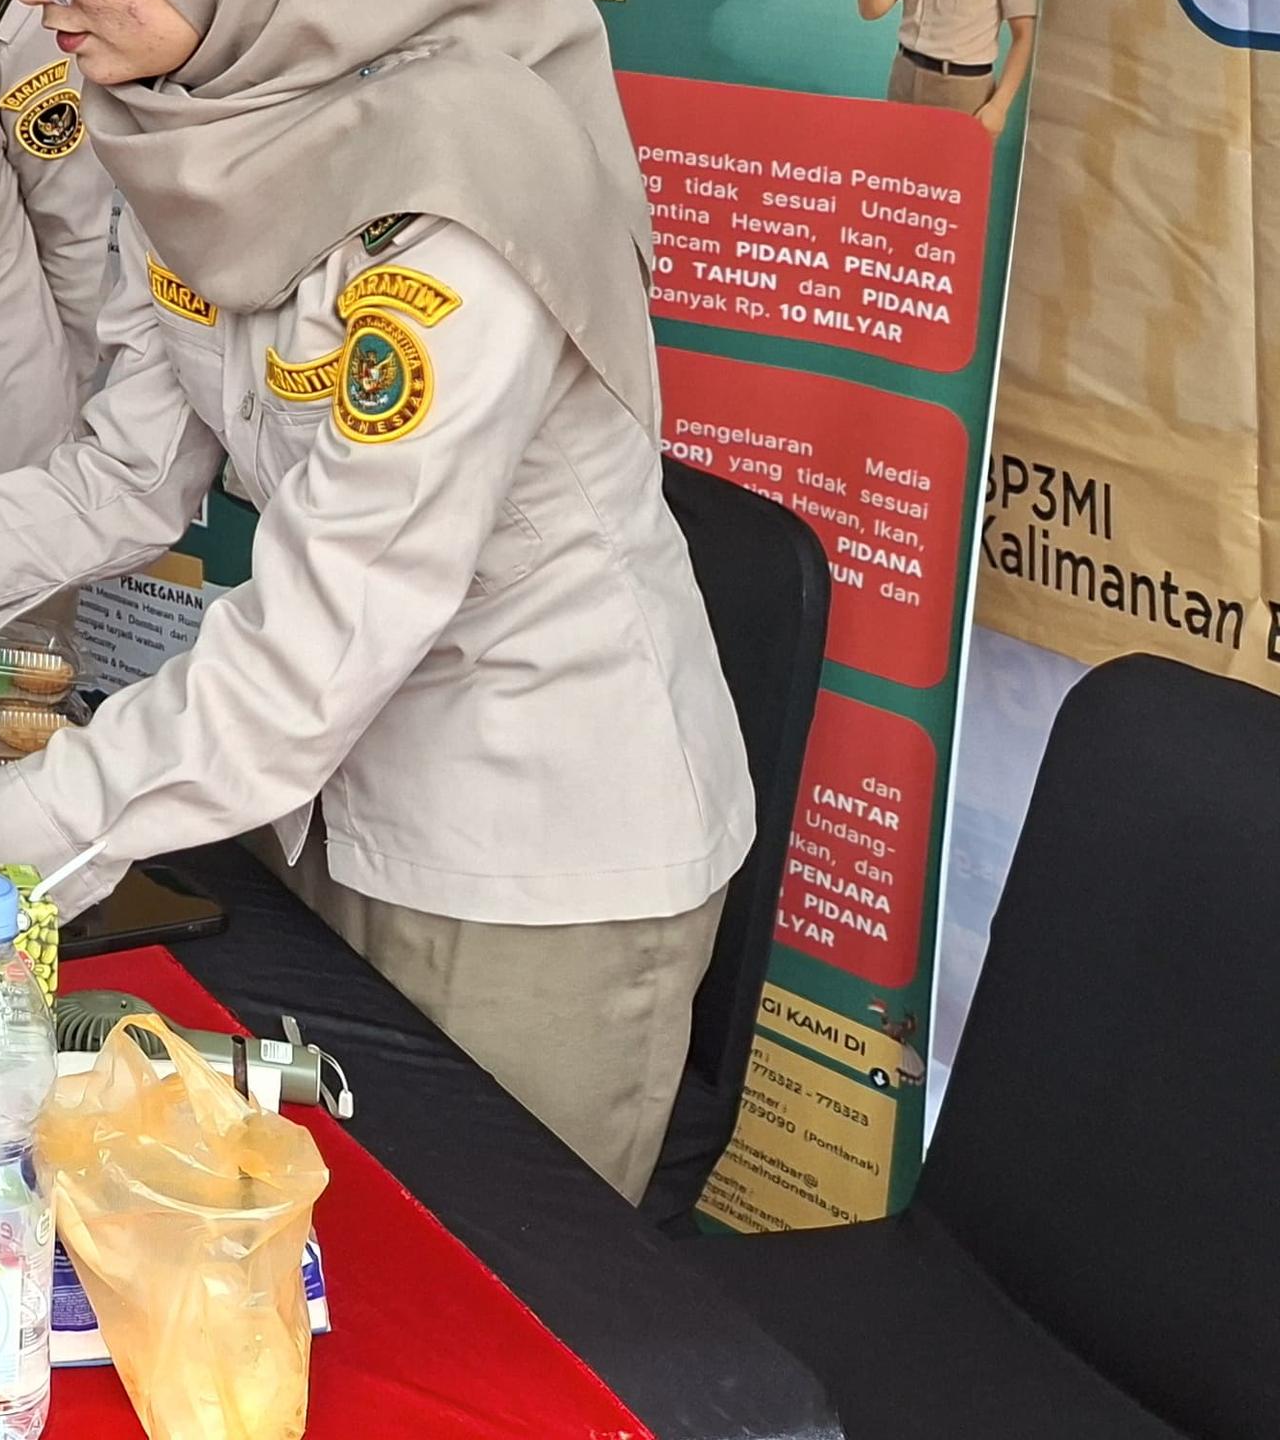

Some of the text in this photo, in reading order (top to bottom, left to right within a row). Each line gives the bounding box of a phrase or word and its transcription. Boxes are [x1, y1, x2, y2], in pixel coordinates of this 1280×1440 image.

[685, 177, 738, 201] tidak
[761, 190, 836, 213] sesuai
[771, 160, 961, 204] Media Pembawa
[736, 242, 953, 294] PIDANA PENJARA
[915, 240, 956, 265] dan
[693, 261, 951, 324] TAHUN dan PIDANA
[779, 304, 903, 343] 10 MILYAR
[676, 417, 813, 457] pengeluaran
[119, 574, 204, 611] PENCEGAHAN
[787, 1008, 867, 1057] KAMI DI
